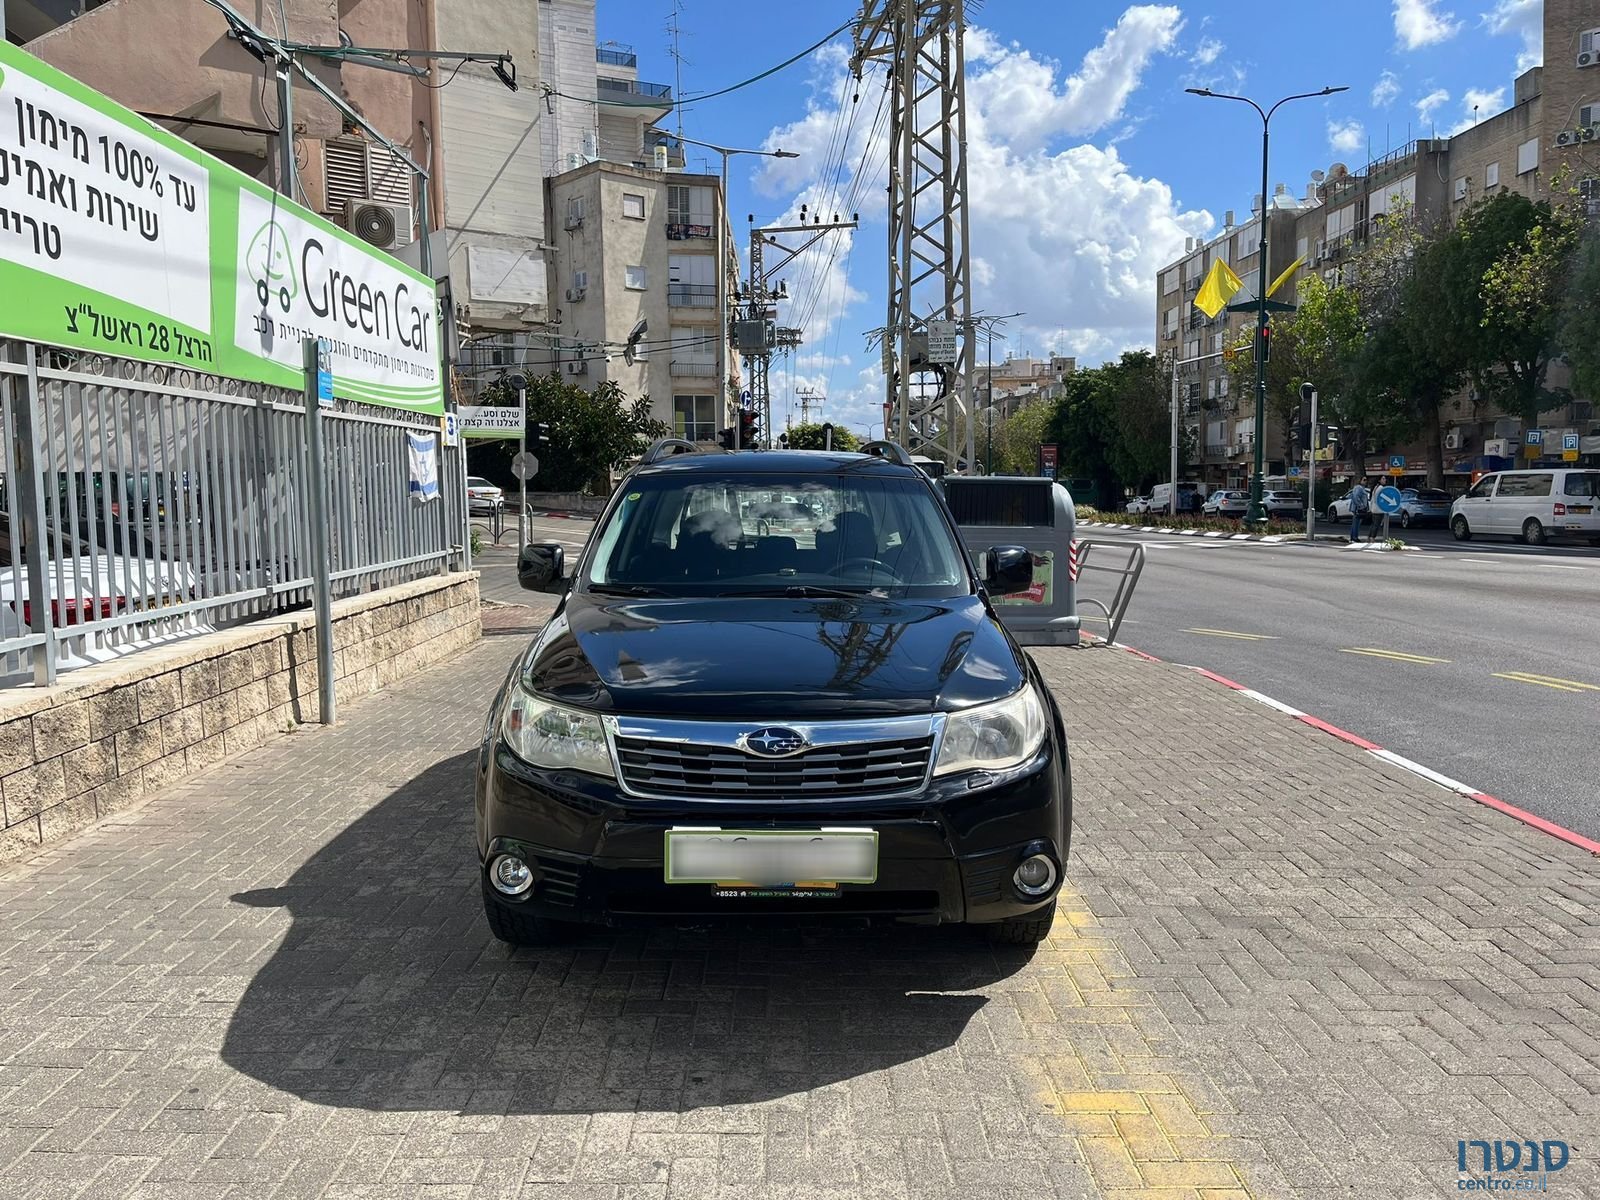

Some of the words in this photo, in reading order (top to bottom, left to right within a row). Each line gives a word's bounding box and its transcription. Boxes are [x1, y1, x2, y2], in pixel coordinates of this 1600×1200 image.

[14, 96, 90, 165] מימון
[98, 135, 164, 199] 100%
[168, 173, 196, 213] עד
[86, 184, 159, 242] שירות
[301, 238, 390, 340] Green
[394, 282, 430, 353] Car
[253, 315, 275, 336] רכב
[147, 322, 170, 353] 28
[173, 327, 213, 363] הרצל
[318, 335, 350, 358] והוגנ
[353, 346, 389, 368] מתקדמים
[390, 356, 409, 374] מימון
[464, 418, 483, 428] קצת
[475, 410, 498, 418] וסע...
[497, 418, 520, 427] אצלנו
[500, 409, 520, 418] שלם
